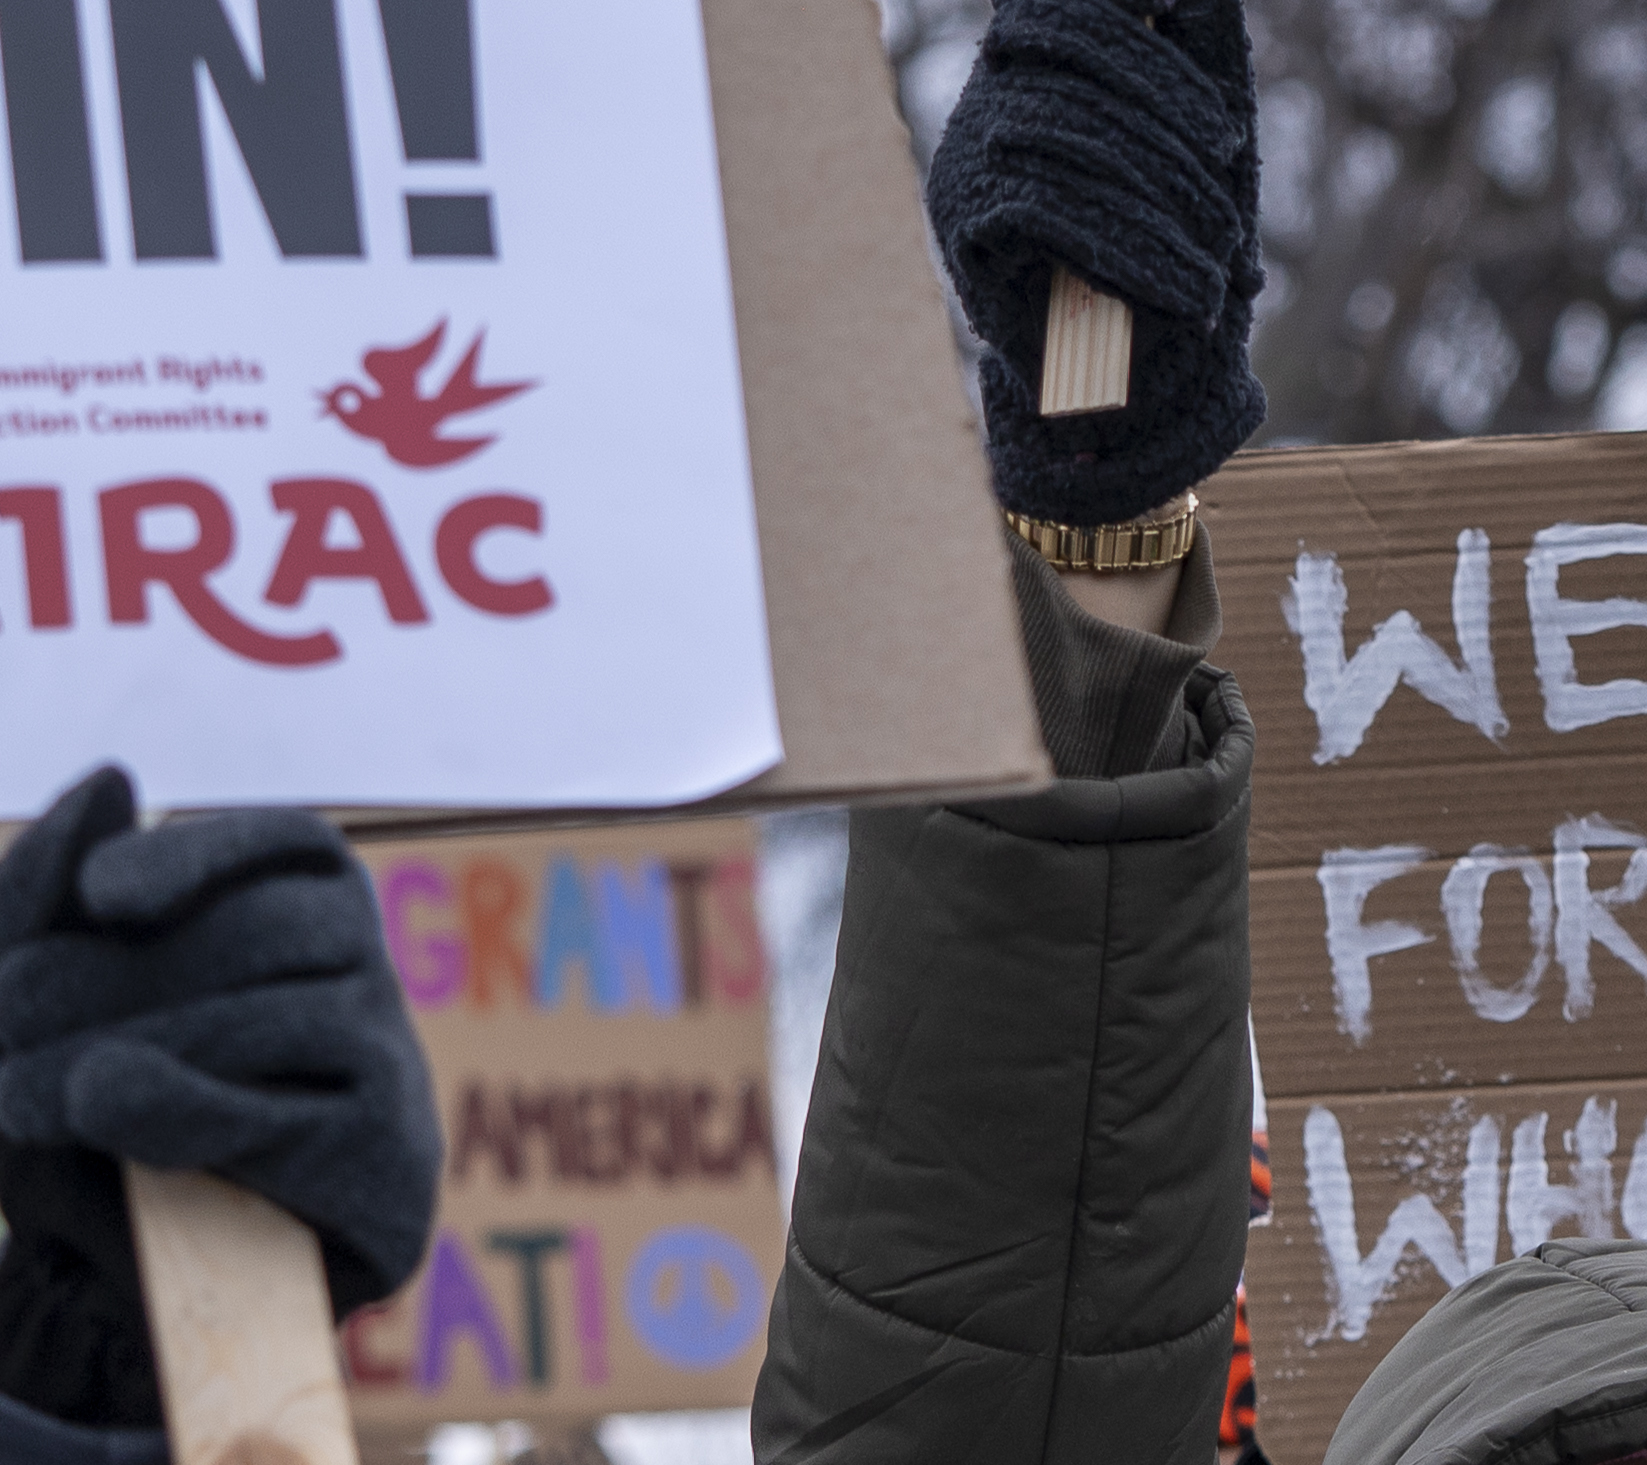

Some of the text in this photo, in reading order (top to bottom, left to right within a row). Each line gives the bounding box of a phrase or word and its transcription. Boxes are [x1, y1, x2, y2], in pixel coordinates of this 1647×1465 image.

[157, 353, 265, 394] Rights
[86, 401, 271, 435] Committee
[382, 852, 774, 1024] GRANTS
